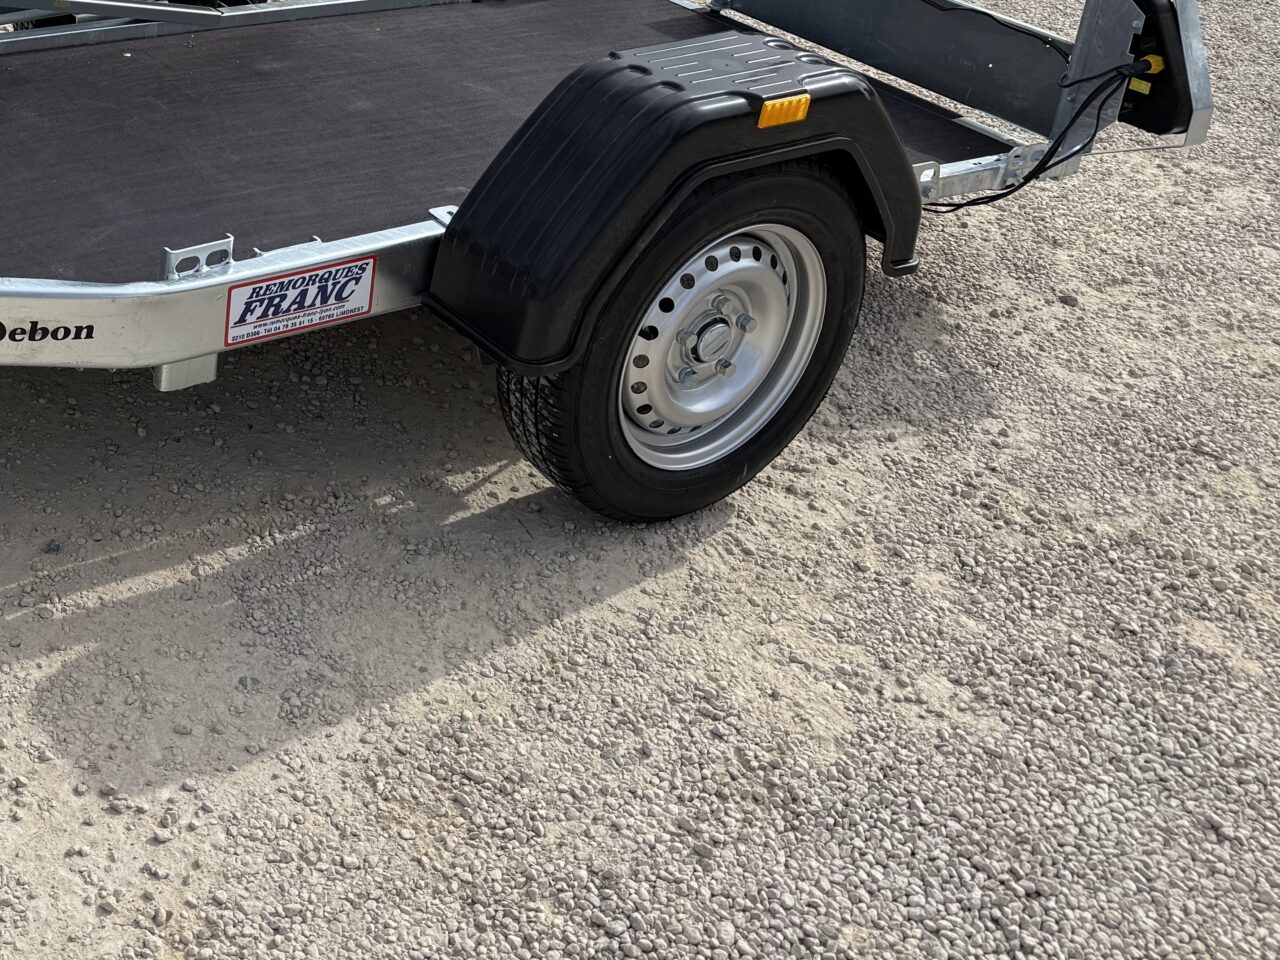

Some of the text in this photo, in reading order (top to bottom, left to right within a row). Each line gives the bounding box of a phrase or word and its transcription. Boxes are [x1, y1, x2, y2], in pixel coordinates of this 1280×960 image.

[246, 261, 370, 300] REMORQUES
[233, 276, 363, 325] FRANC
[335, 305, 365, 317] LIMONEST
